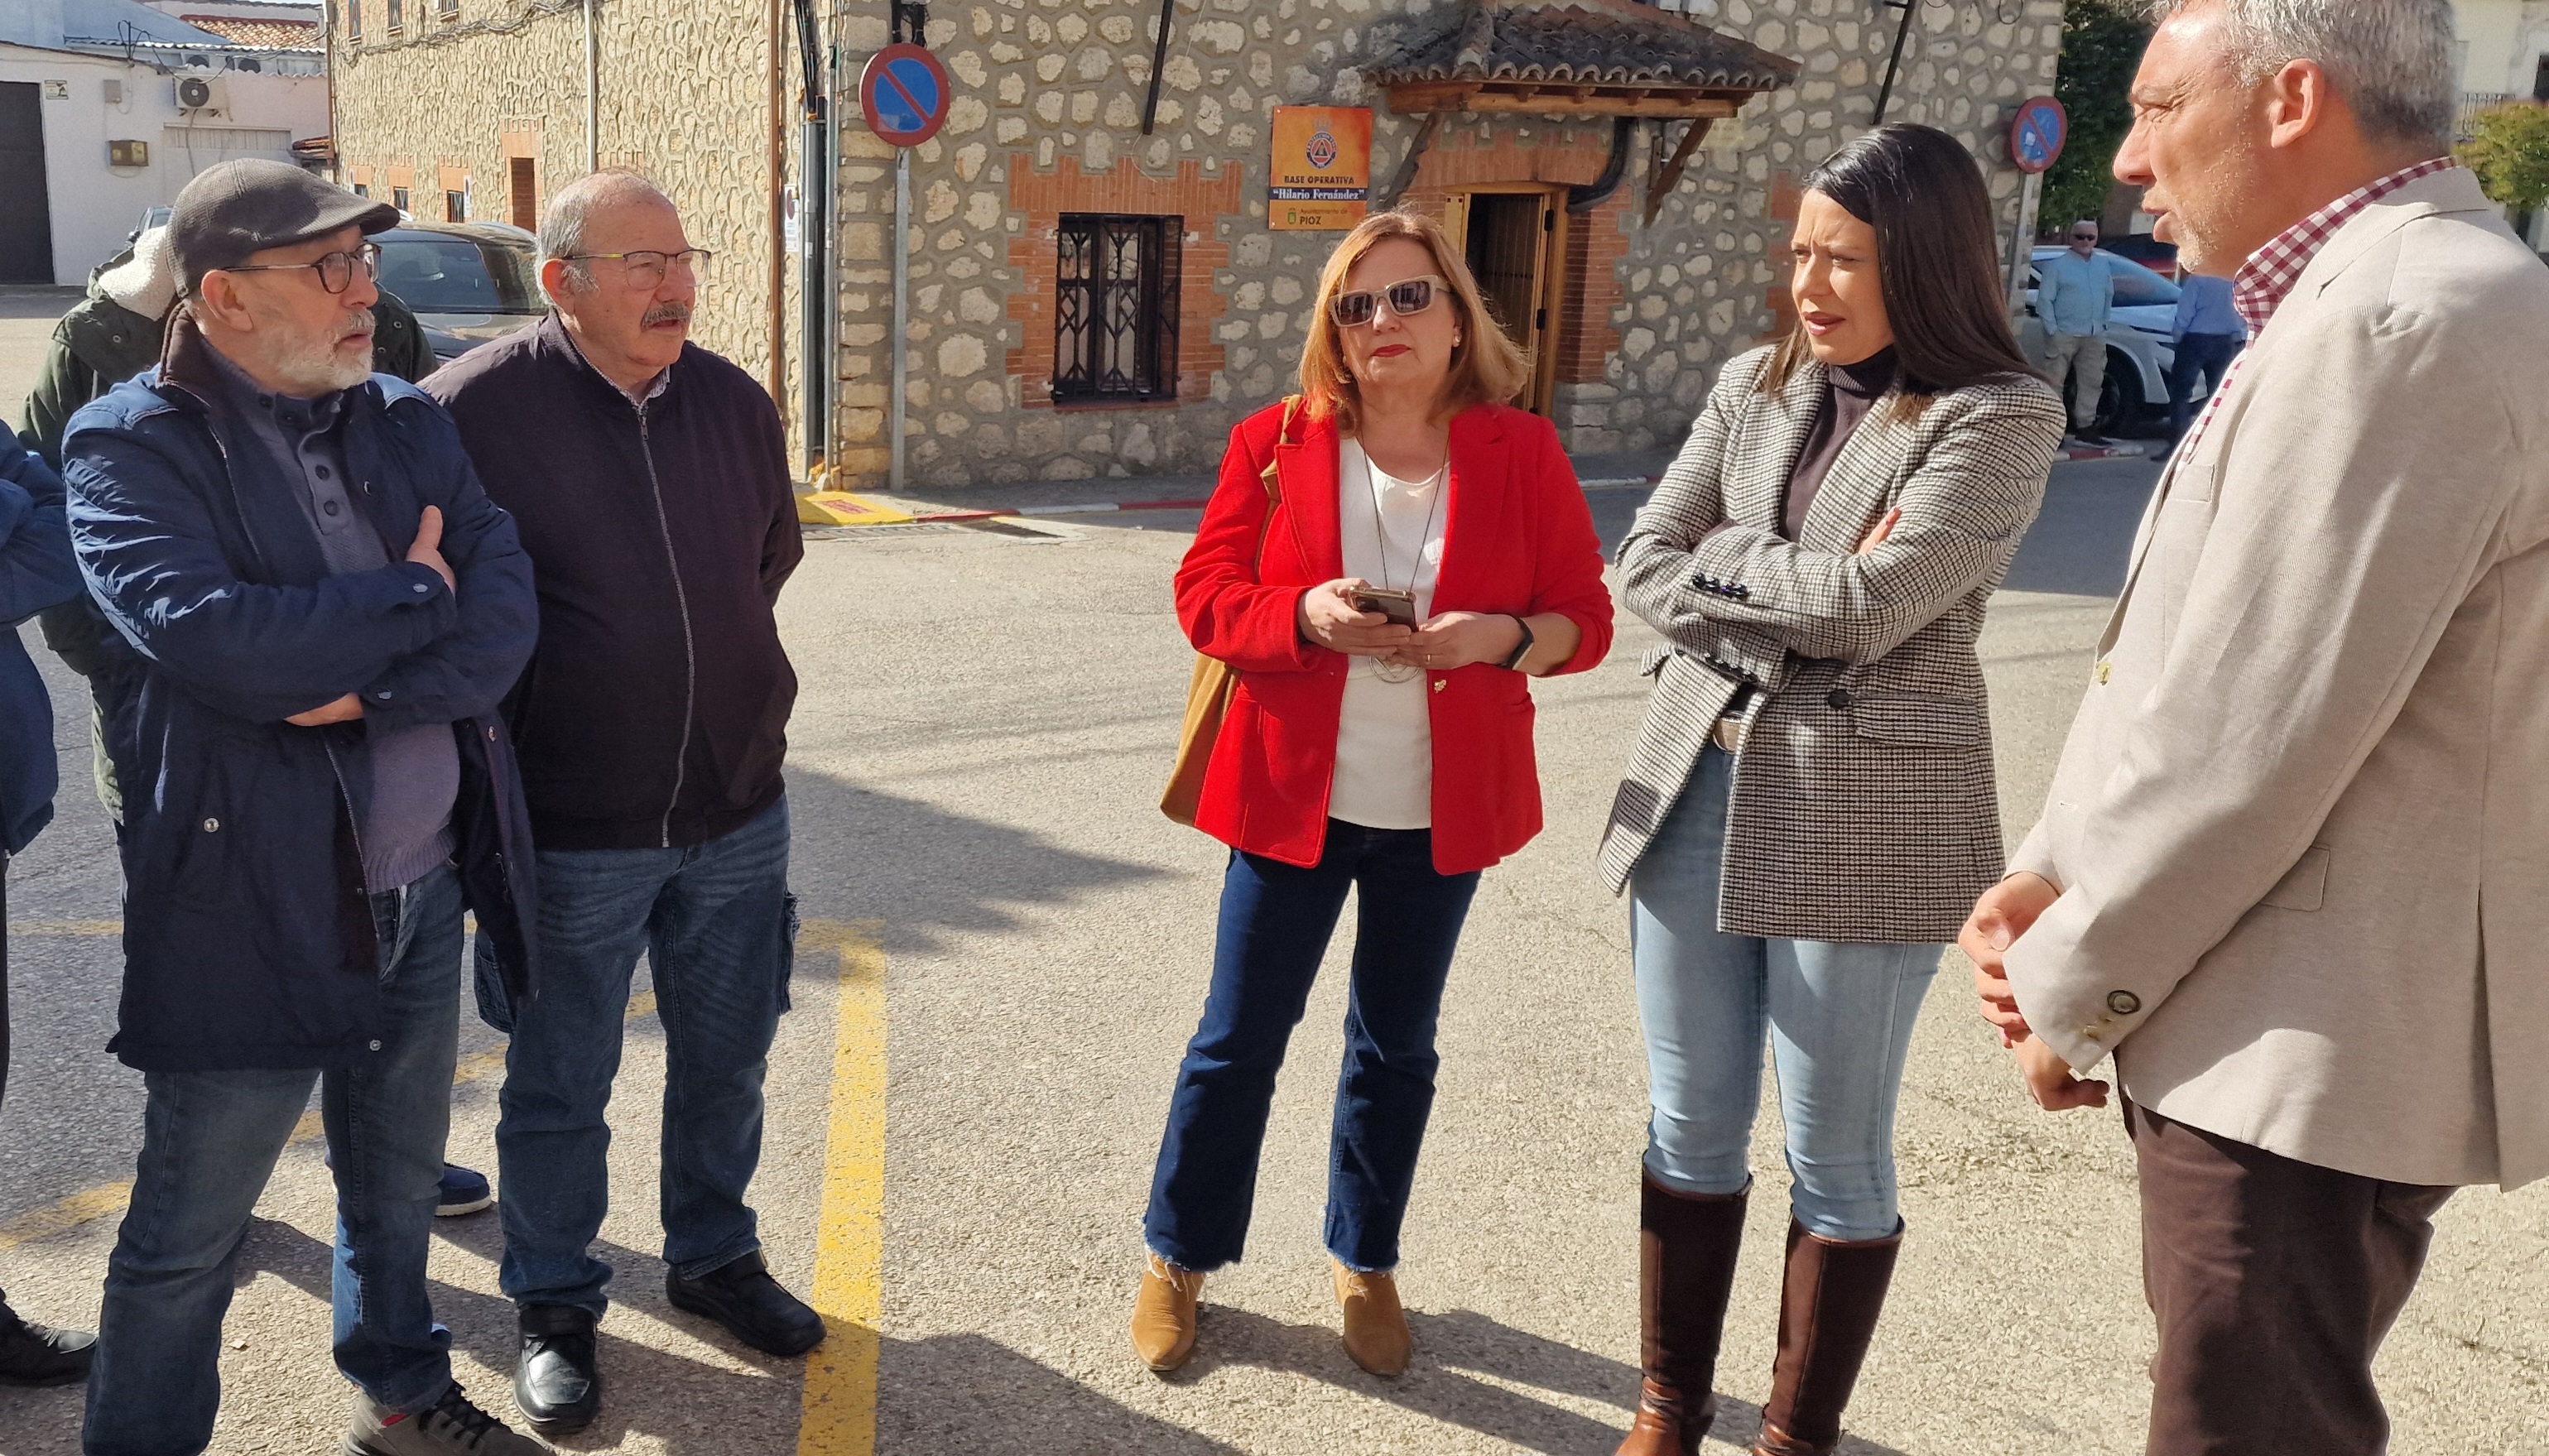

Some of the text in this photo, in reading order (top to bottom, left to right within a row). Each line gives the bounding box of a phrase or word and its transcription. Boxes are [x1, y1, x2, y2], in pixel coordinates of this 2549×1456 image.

[1284, 175, 1354, 185] BASE OPERATIVA
[1300, 216, 1321, 225] PIOZ
